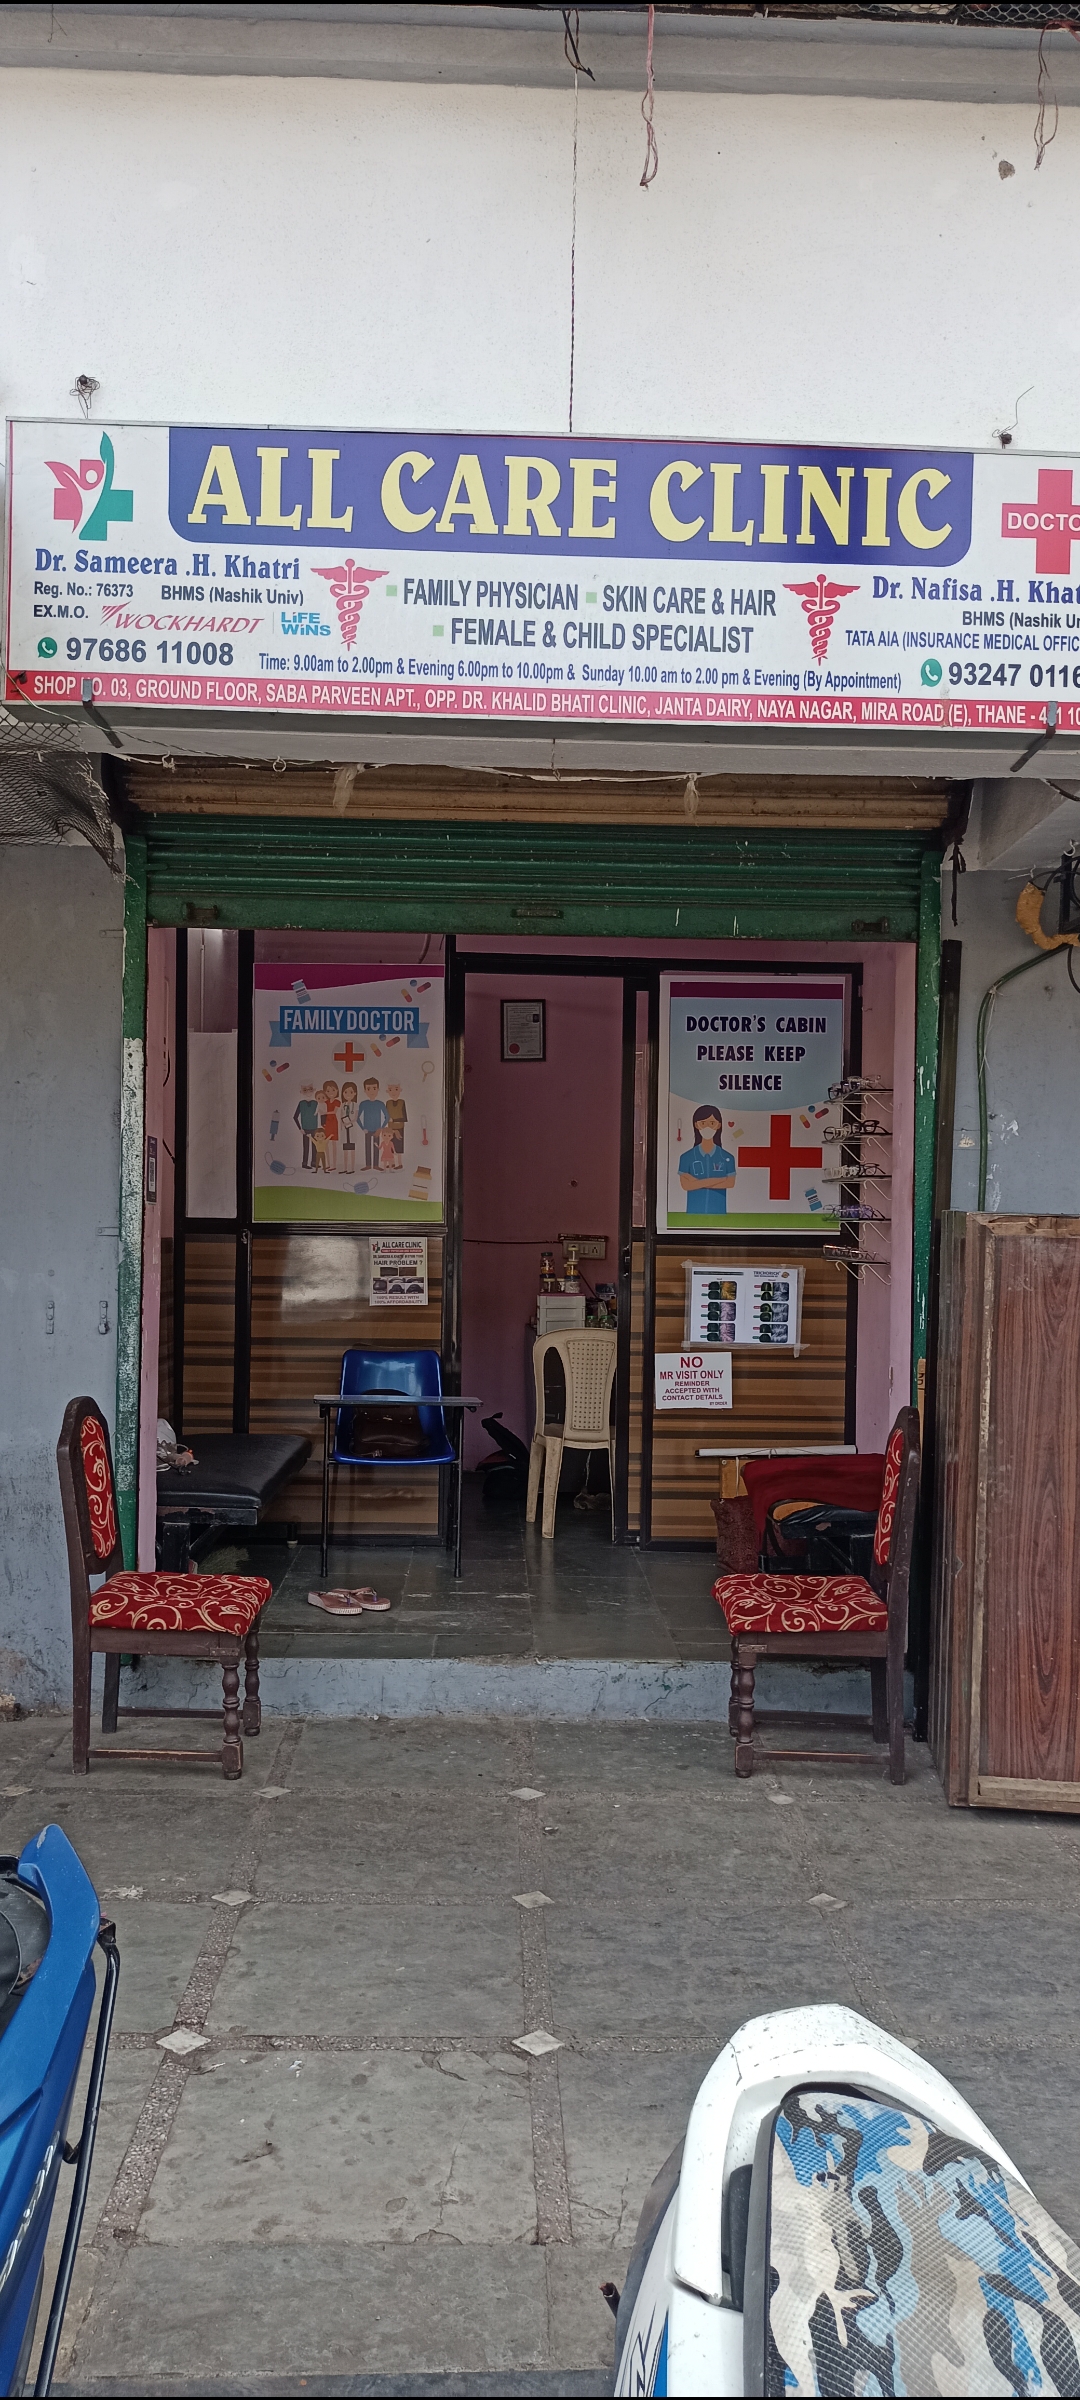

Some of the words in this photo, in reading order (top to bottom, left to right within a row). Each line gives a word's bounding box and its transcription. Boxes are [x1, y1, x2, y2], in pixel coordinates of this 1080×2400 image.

[187, 445, 354, 533] ALL
[380, 451, 617, 540] CARE
[649, 460, 953, 550] CLINIC
[1007, 512, 1080, 532] DOCTO
[35, 548, 66, 572] Dr.
[74, 549, 177, 576] Sameera
[186, 554, 216, 577] .H.
[224, 555, 300, 580] Khatri
[34, 581, 62, 598] Reg.
[66, 582, 92, 597] No.:
[96, 583, 134, 598] 76373
[161, 585, 204, 601] BHMS
[209, 586, 262, 605] (Nashik
[266, 588, 304, 606] Univ)
[404, 578, 471, 607] FAMILY
[476, 581, 578, 611] PHYSICIAN
[603, 584, 647, 612] SKIN
[653, 586, 706, 614] CARE
[711, 587, 725, 615] &
[731, 588, 776, 616] HAIR
[872, 575, 903, 599] Dr.
[911, 576, 982, 602] Nafisa
[991, 579, 1020, 603] .H.
[33, 605, 89, 619] EX.M.O.
[962, 611, 1005, 627] BHMS
[1009, 611, 1061, 631] (Nashik
[115, 613, 265, 634] WOCKHARDT
[451, 618, 536, 647] FEMALE
[542, 620, 557, 648] &
[563, 621, 625, 650] CHILD
[632, 624, 754, 653] SPECIALIST
[845, 630, 876, 647] TATA
[878, 630, 899, 647] AIA
[902, 631, 980, 652] (INSURANCE
[983, 633, 1040, 651] MEDICAL
[66, 637, 147, 663] 97686
[156, 640, 234, 666] 11008
[259, 653, 290, 671] Time:
[293, 655, 334, 673] 9.00am
[337, 657, 349, 673] to
[352, 657, 393, 678] 2.00pm
[396, 658, 405, 674] &
[408, 659, 454, 680] Evening
[458, 660, 499, 682] 6.00pm
[502, 662, 513, 678] to
[517, 662, 564, 684] 10.00pm
[567, 664, 575, 680] &
[582, 664, 624, 686] Sunday
[629, 666, 658, 683] 10.00
[661, 670, 678, 684] am
[681, 668, 692, 684] to
[696, 667, 718, 685] 2.00
[722, 671, 739, 688] pm
[742, 670, 751, 686] &
[754, 670, 800, 691] Evening
[803, 670, 822, 692] (By
[825, 671, 901, 694] Appointment)
[948, 661, 1022, 687] 93247
[34, 675, 76, 695] SHOP
[111, 678, 131, 700] 03,
[136, 680, 201, 700] GROUND
[206, 681, 262, 704] FLOOR,
[266, 683, 308, 704] SABA
[312, 685, 381, 706] PARVEEN
[385, 687, 421, 711] APT.,
[425, 689, 458, 709] OPP.
[462, 690, 487, 710] DR.
[491, 691, 547, 712] KHALID
[552, 693, 595, 714] BHATI
[598, 694, 651, 718] CLINIC,
[655, 696, 703, 717] JANTA
[706, 697, 753, 720] DAIRY,
[757, 699, 796, 719] NAYA
[800, 700, 857, 723] NAGAR,
[861, 702, 900, 722] MIRA
[902, 703, 944, 723] ROAD
[948, 703, 972, 727] (E),
[976, 704, 1026, 724] THANE
[1039, 706, 1062, 725] 41
[283, 1009, 344, 1031] FAMILY
[346, 1010, 415, 1032] DOCTOR
[686, 1014, 766, 1033] DOCTOR'S
[776, 1016, 827, 1034] CABIN
[697, 1045, 754, 1062] PLEASE
[764, 1046, 806, 1062] KEEP
[719, 1074, 782, 1091] SILENCE
[680, 1356, 703, 1368] NO
[659, 1371, 674, 1380] MR
[675, 1371, 699, 1379] VISIT
[700, 1370, 724, 1379] ONLY
